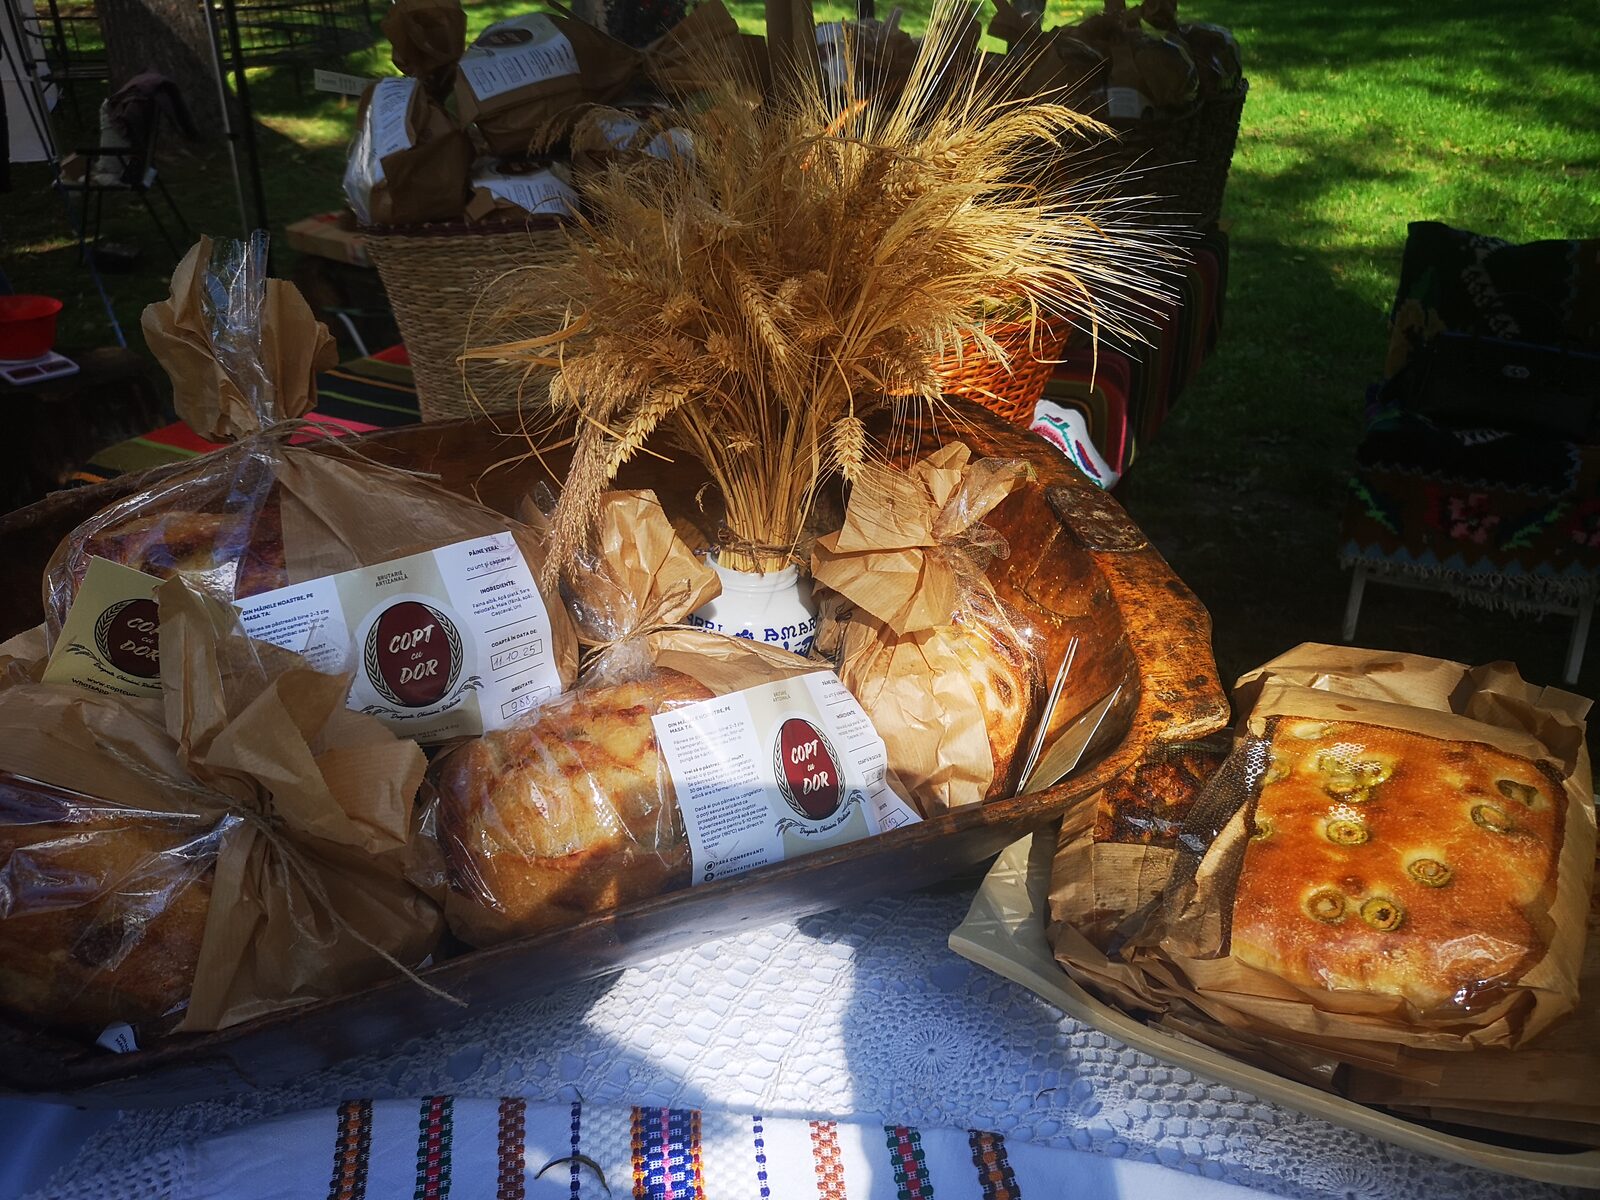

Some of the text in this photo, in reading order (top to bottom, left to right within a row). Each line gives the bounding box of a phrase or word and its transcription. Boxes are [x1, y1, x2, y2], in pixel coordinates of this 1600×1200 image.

[377, 570, 403, 581] BRUTARIE
[253, 602, 277, 613] MÂINILE
[243, 614, 261, 622] MASA
[389, 624, 436, 654] COPT
[491, 637, 511, 648] COAPTĂ
[516, 631, 530, 639] DATA
[411, 651, 424, 661] cu
[399, 659, 439, 685] DOR
[669, 726, 684, 734] MASA
[790, 739, 819, 765] COPT
[807, 762, 816, 772] cu
[802, 771, 830, 796] DOR
[694, 804, 707, 813] Dacă
[720, 797, 736, 806] pâinea
[751, 812, 768, 821] minute
[715, 858, 730, 867] FĂRĂ
